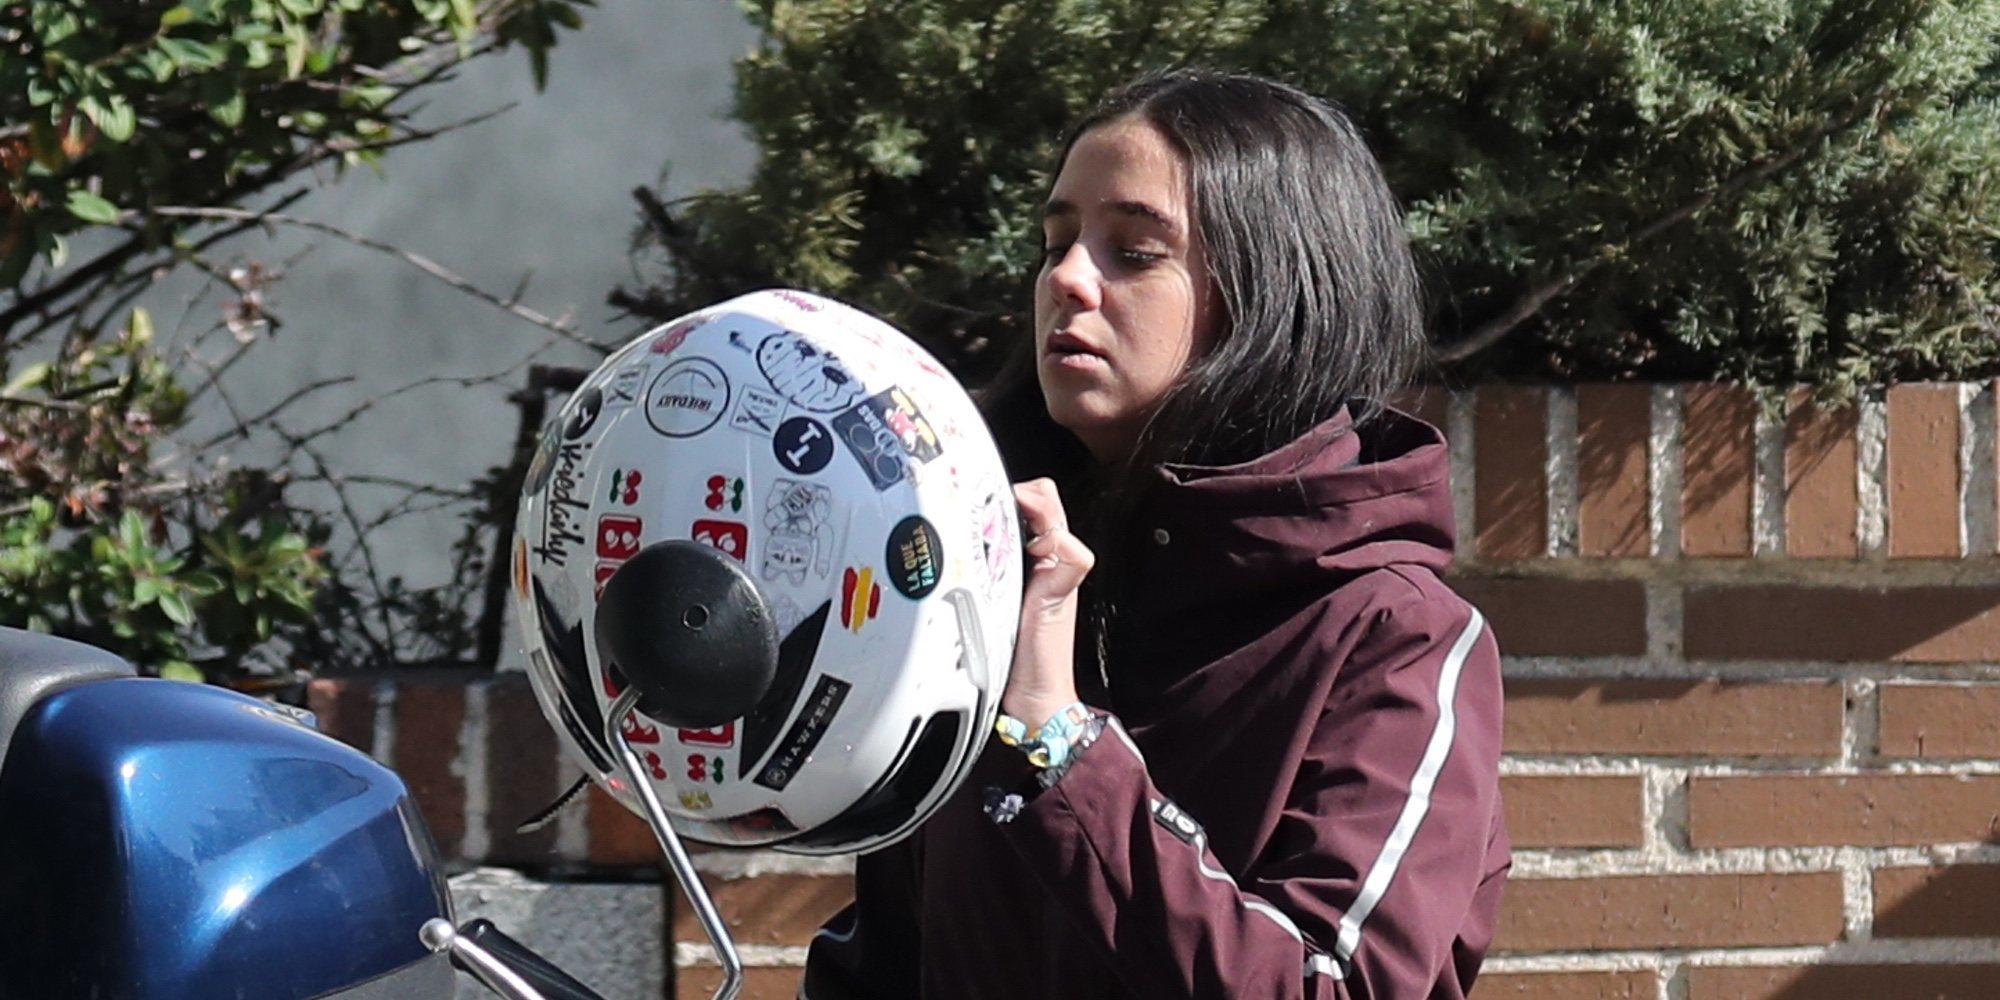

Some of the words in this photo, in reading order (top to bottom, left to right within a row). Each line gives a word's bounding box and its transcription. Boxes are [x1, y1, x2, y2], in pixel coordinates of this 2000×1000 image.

[901, 536, 915, 570] QUE
[906, 573, 921, 593] LA
[781, 683, 839, 769] HAWKERS
